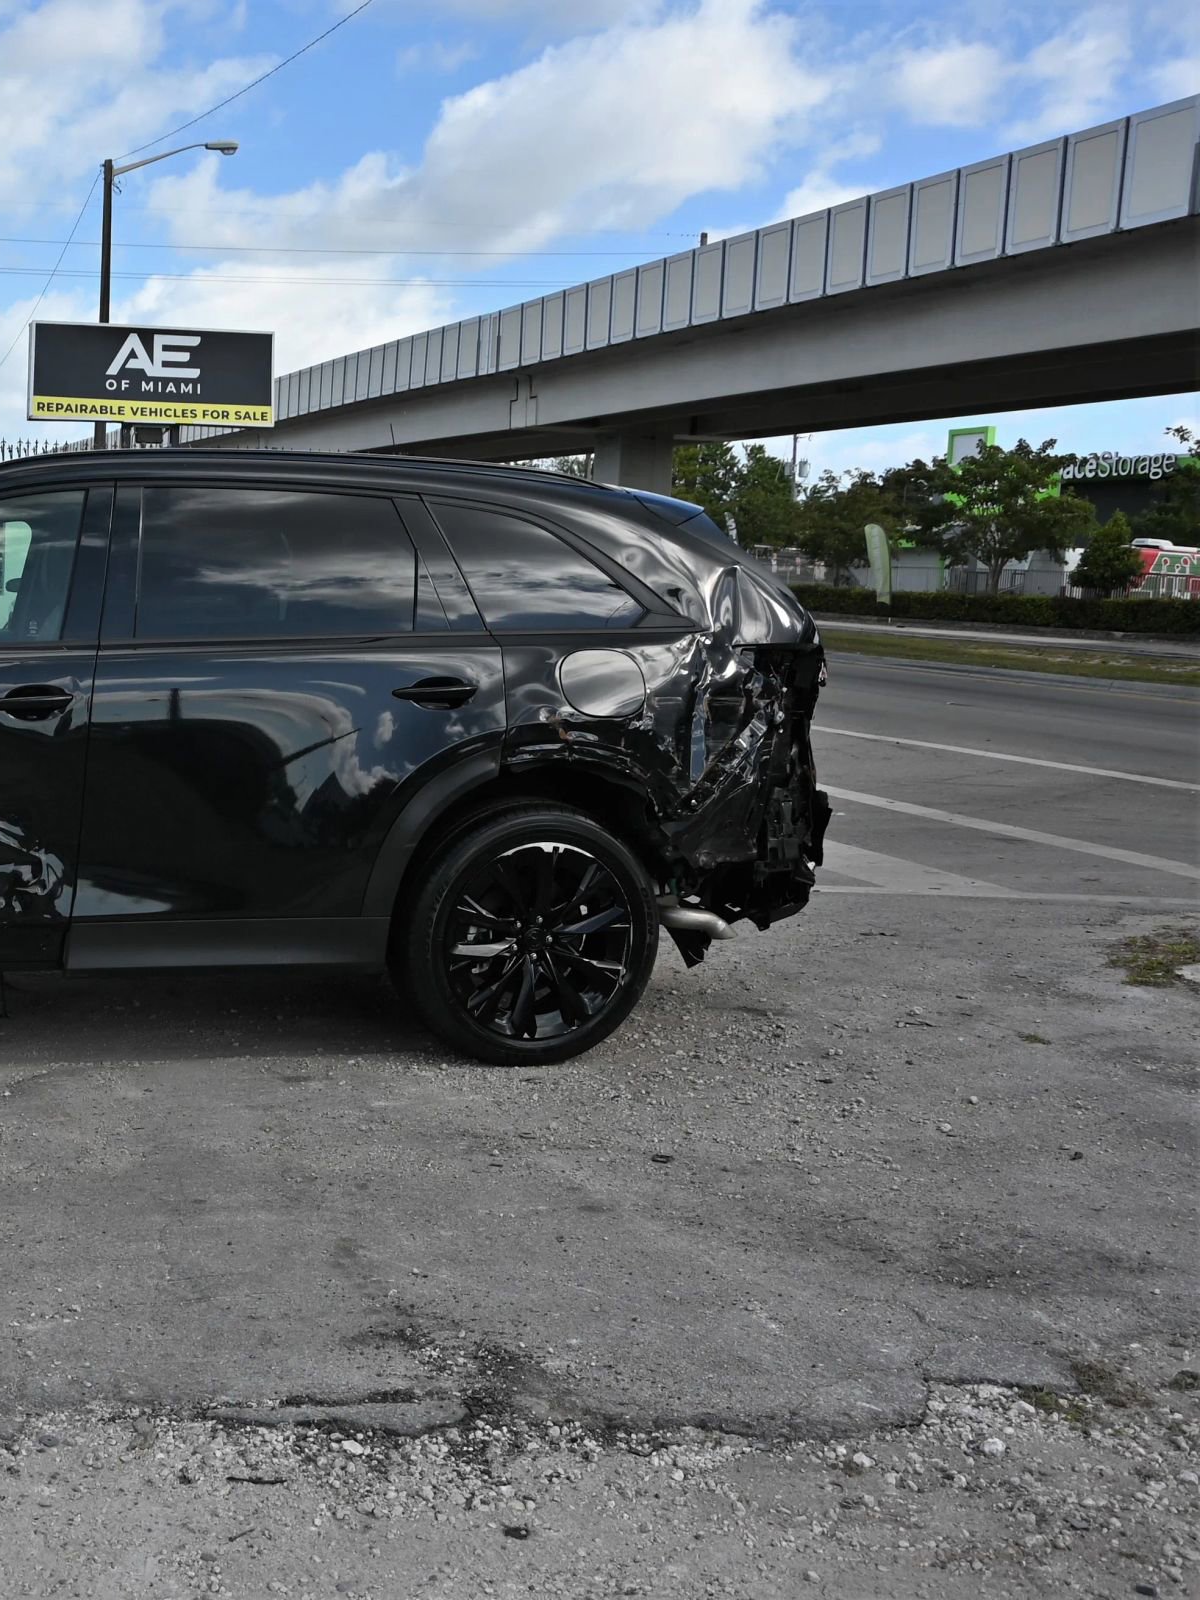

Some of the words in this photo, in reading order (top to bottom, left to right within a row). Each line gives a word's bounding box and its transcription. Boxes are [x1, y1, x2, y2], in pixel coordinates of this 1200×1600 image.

[105, 333, 201, 379] AE
[105, 379, 131, 391] OF
[141, 381, 201, 395] MIAMI
[36, 401, 125, 416] REPAIRABLE
[130, 406, 198, 419] VEHICLES
[202, 409, 230, 420] FOR
[234, 411, 269, 421] SALE
